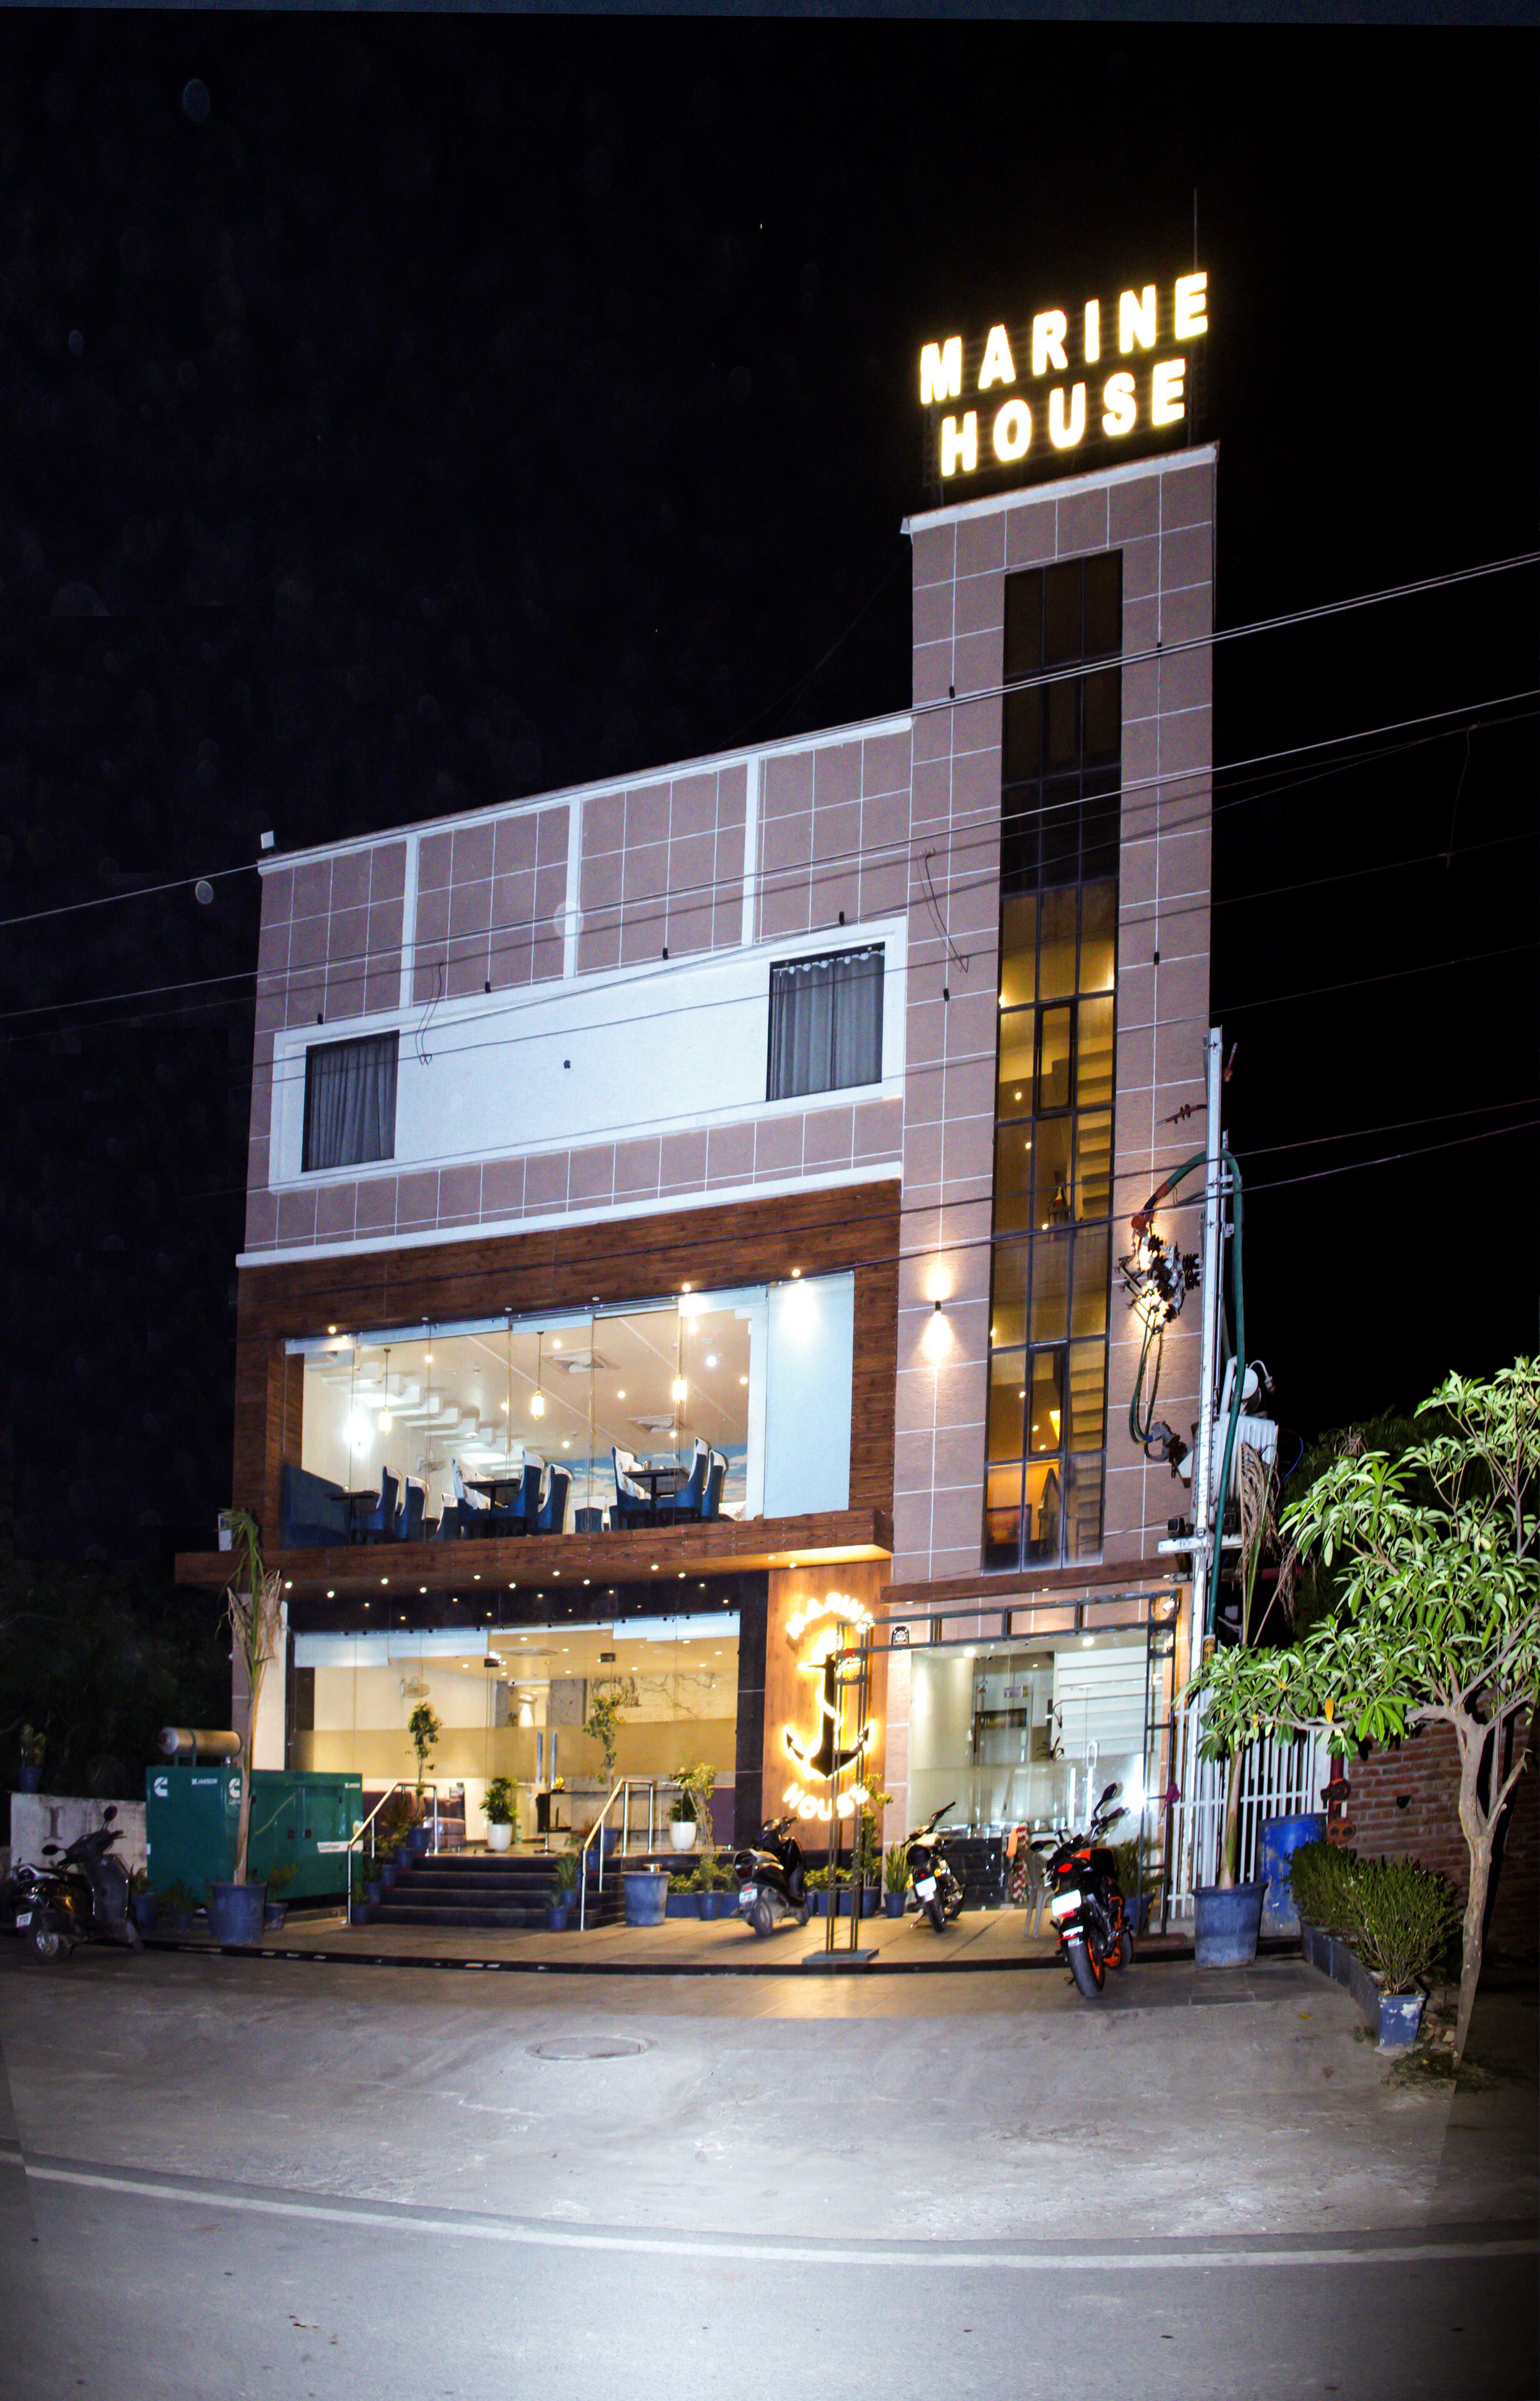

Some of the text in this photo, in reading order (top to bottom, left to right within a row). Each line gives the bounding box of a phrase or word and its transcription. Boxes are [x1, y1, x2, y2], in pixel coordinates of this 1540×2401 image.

[920, 271, 1208, 405] MARINE
[941, 358, 1185, 476] HOUSE
[785, 1592, 874, 1639] MARINE
[782, 1782, 870, 1821] HOUSE
